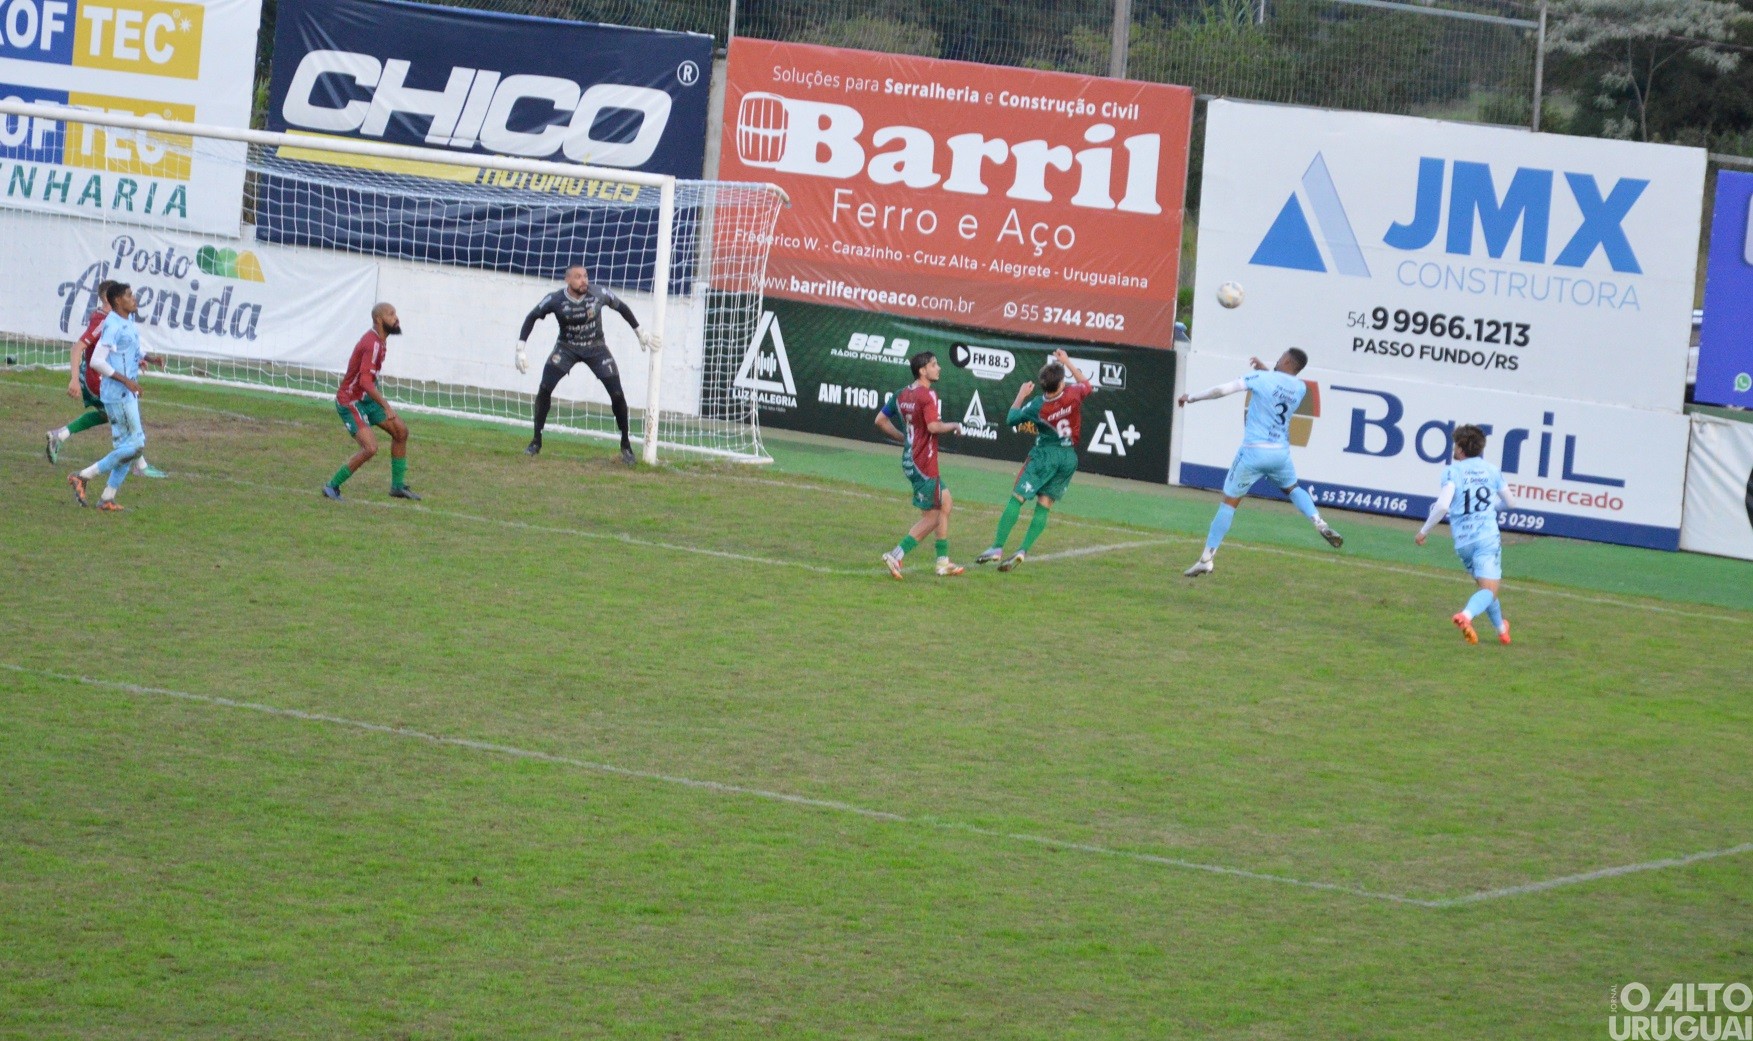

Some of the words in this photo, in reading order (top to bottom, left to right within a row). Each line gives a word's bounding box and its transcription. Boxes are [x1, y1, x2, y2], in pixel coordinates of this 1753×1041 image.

[0, 0, 68, 51] OF
[283, 49, 672, 167] CHICO
[773, 65, 840, 88] Soluções
[845, 77, 879, 94] para
[884, 78, 979, 104] Serralheria
[984, 90, 994, 104] e
[999, 90, 1096, 118] Construção
[1102, 101, 1140, 121] Civil
[777, 97, 1163, 215] Barril
[0, 162, 188, 218] NHARIA
[832, 188, 938, 235] Ferro
[958, 213, 979, 241] e
[997, 208, 1076, 256] Aço
[1383, 156, 1651, 275] JMX
[111, 235, 194, 280] Posto
[735, 228, 800, 248] Frederico
[803, 236, 821, 251] W.
[832, 240, 902, 261] Carazinho
[913, 250, 946, 267] Cruz
[948, 254, 978, 271] Alta
[989, 258, 1051, 281] Alegrete
[1063, 266, 1148, 290] Uruguaiana
[57, 260, 263, 342] Aenida
[750, 273, 975, 315] www.barrilferroeaco.com.br
[1396, 258, 1640, 312] CONSTRUTORA
[1021, 303, 1039, 321] 55
[1043, 305, 1083, 327] 3744
[1085, 310, 1125, 331] 2062
[860, 352, 911, 366] FORTALEZA
[973, 352, 986, 366] FM
[988, 354, 1010, 369] 88.5
[1102, 364, 1123, 379] TV
[1352, 336, 1415, 359] PASSO
[1419, 343, 1520, 372] FUNDO/RS
[818, 383, 842, 405] AM
[844, 386, 879, 410] 1160
[1274, 402, 1289, 426] 3
[1056, 418, 1073, 438] 6
[1321, 490, 1336, 503] 55
[1462, 486, 1492, 515] 18
[1509, 513, 1545, 529] 0299
